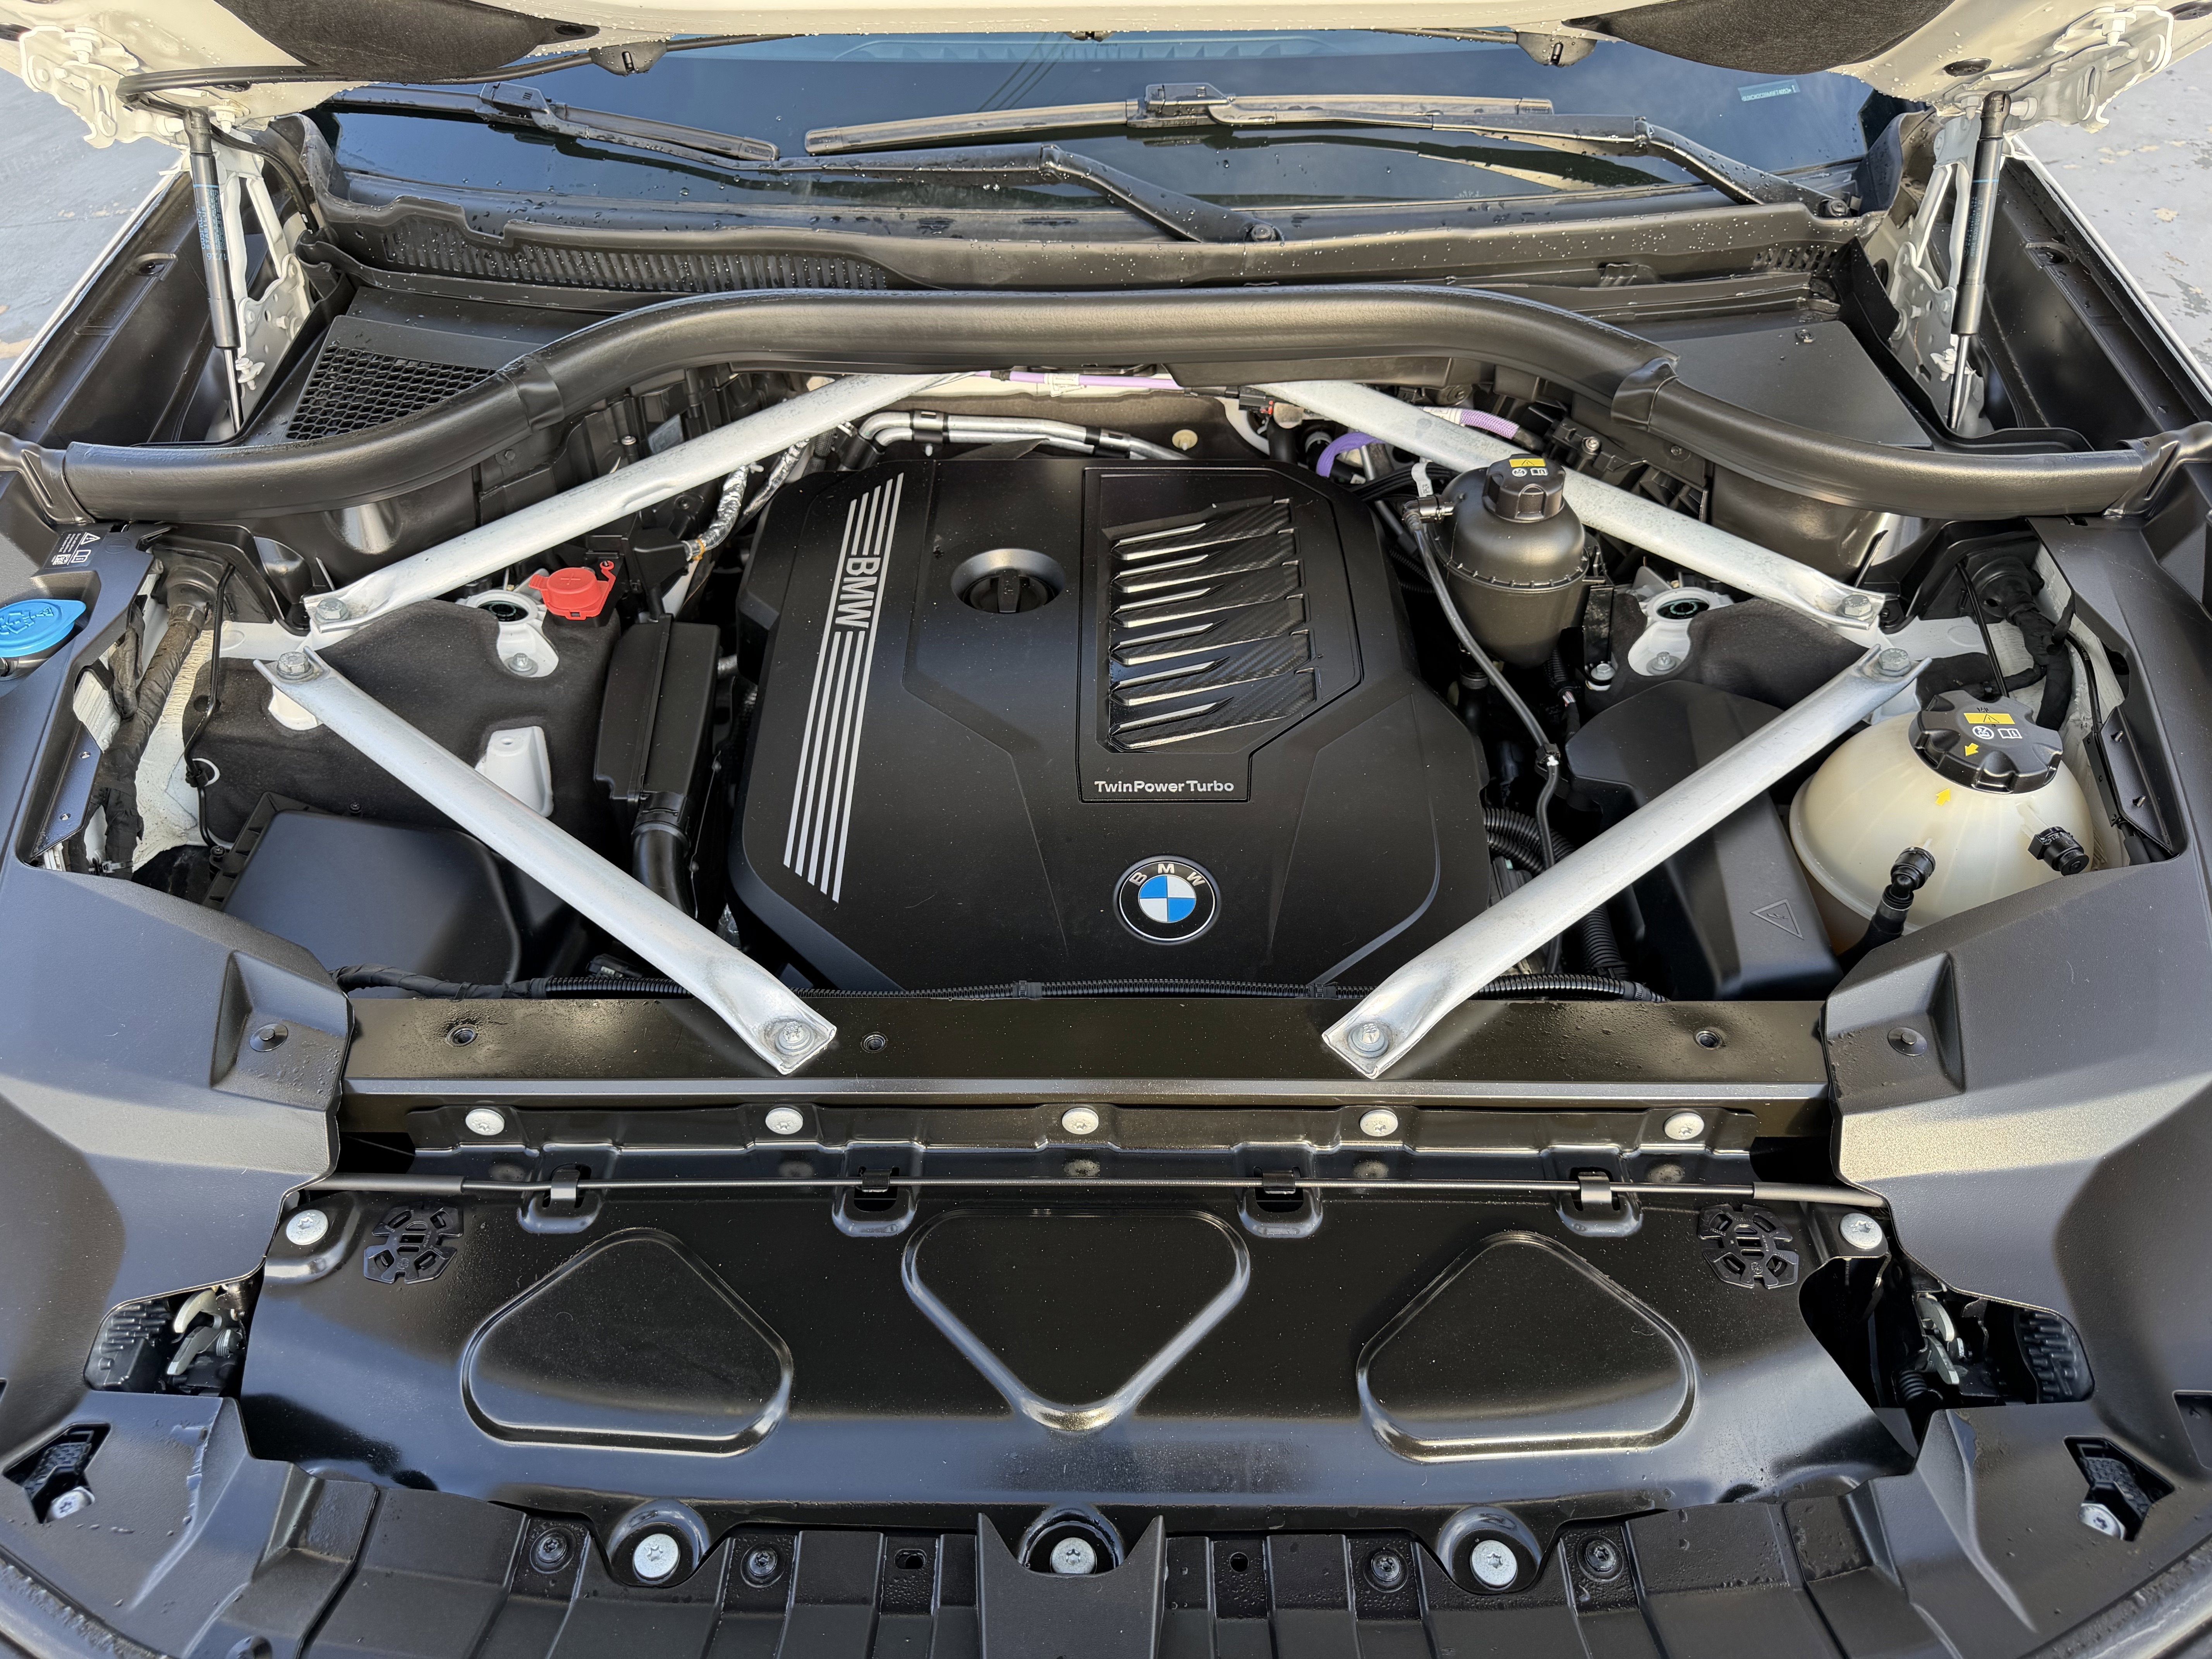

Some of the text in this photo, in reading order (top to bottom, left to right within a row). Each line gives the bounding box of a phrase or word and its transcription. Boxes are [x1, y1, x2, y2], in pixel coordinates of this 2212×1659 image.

[835, 557, 881, 629] BMW
[1094, 780, 1234, 793] TwinPower Turbo
[1130, 863, 1206, 886] BMW
